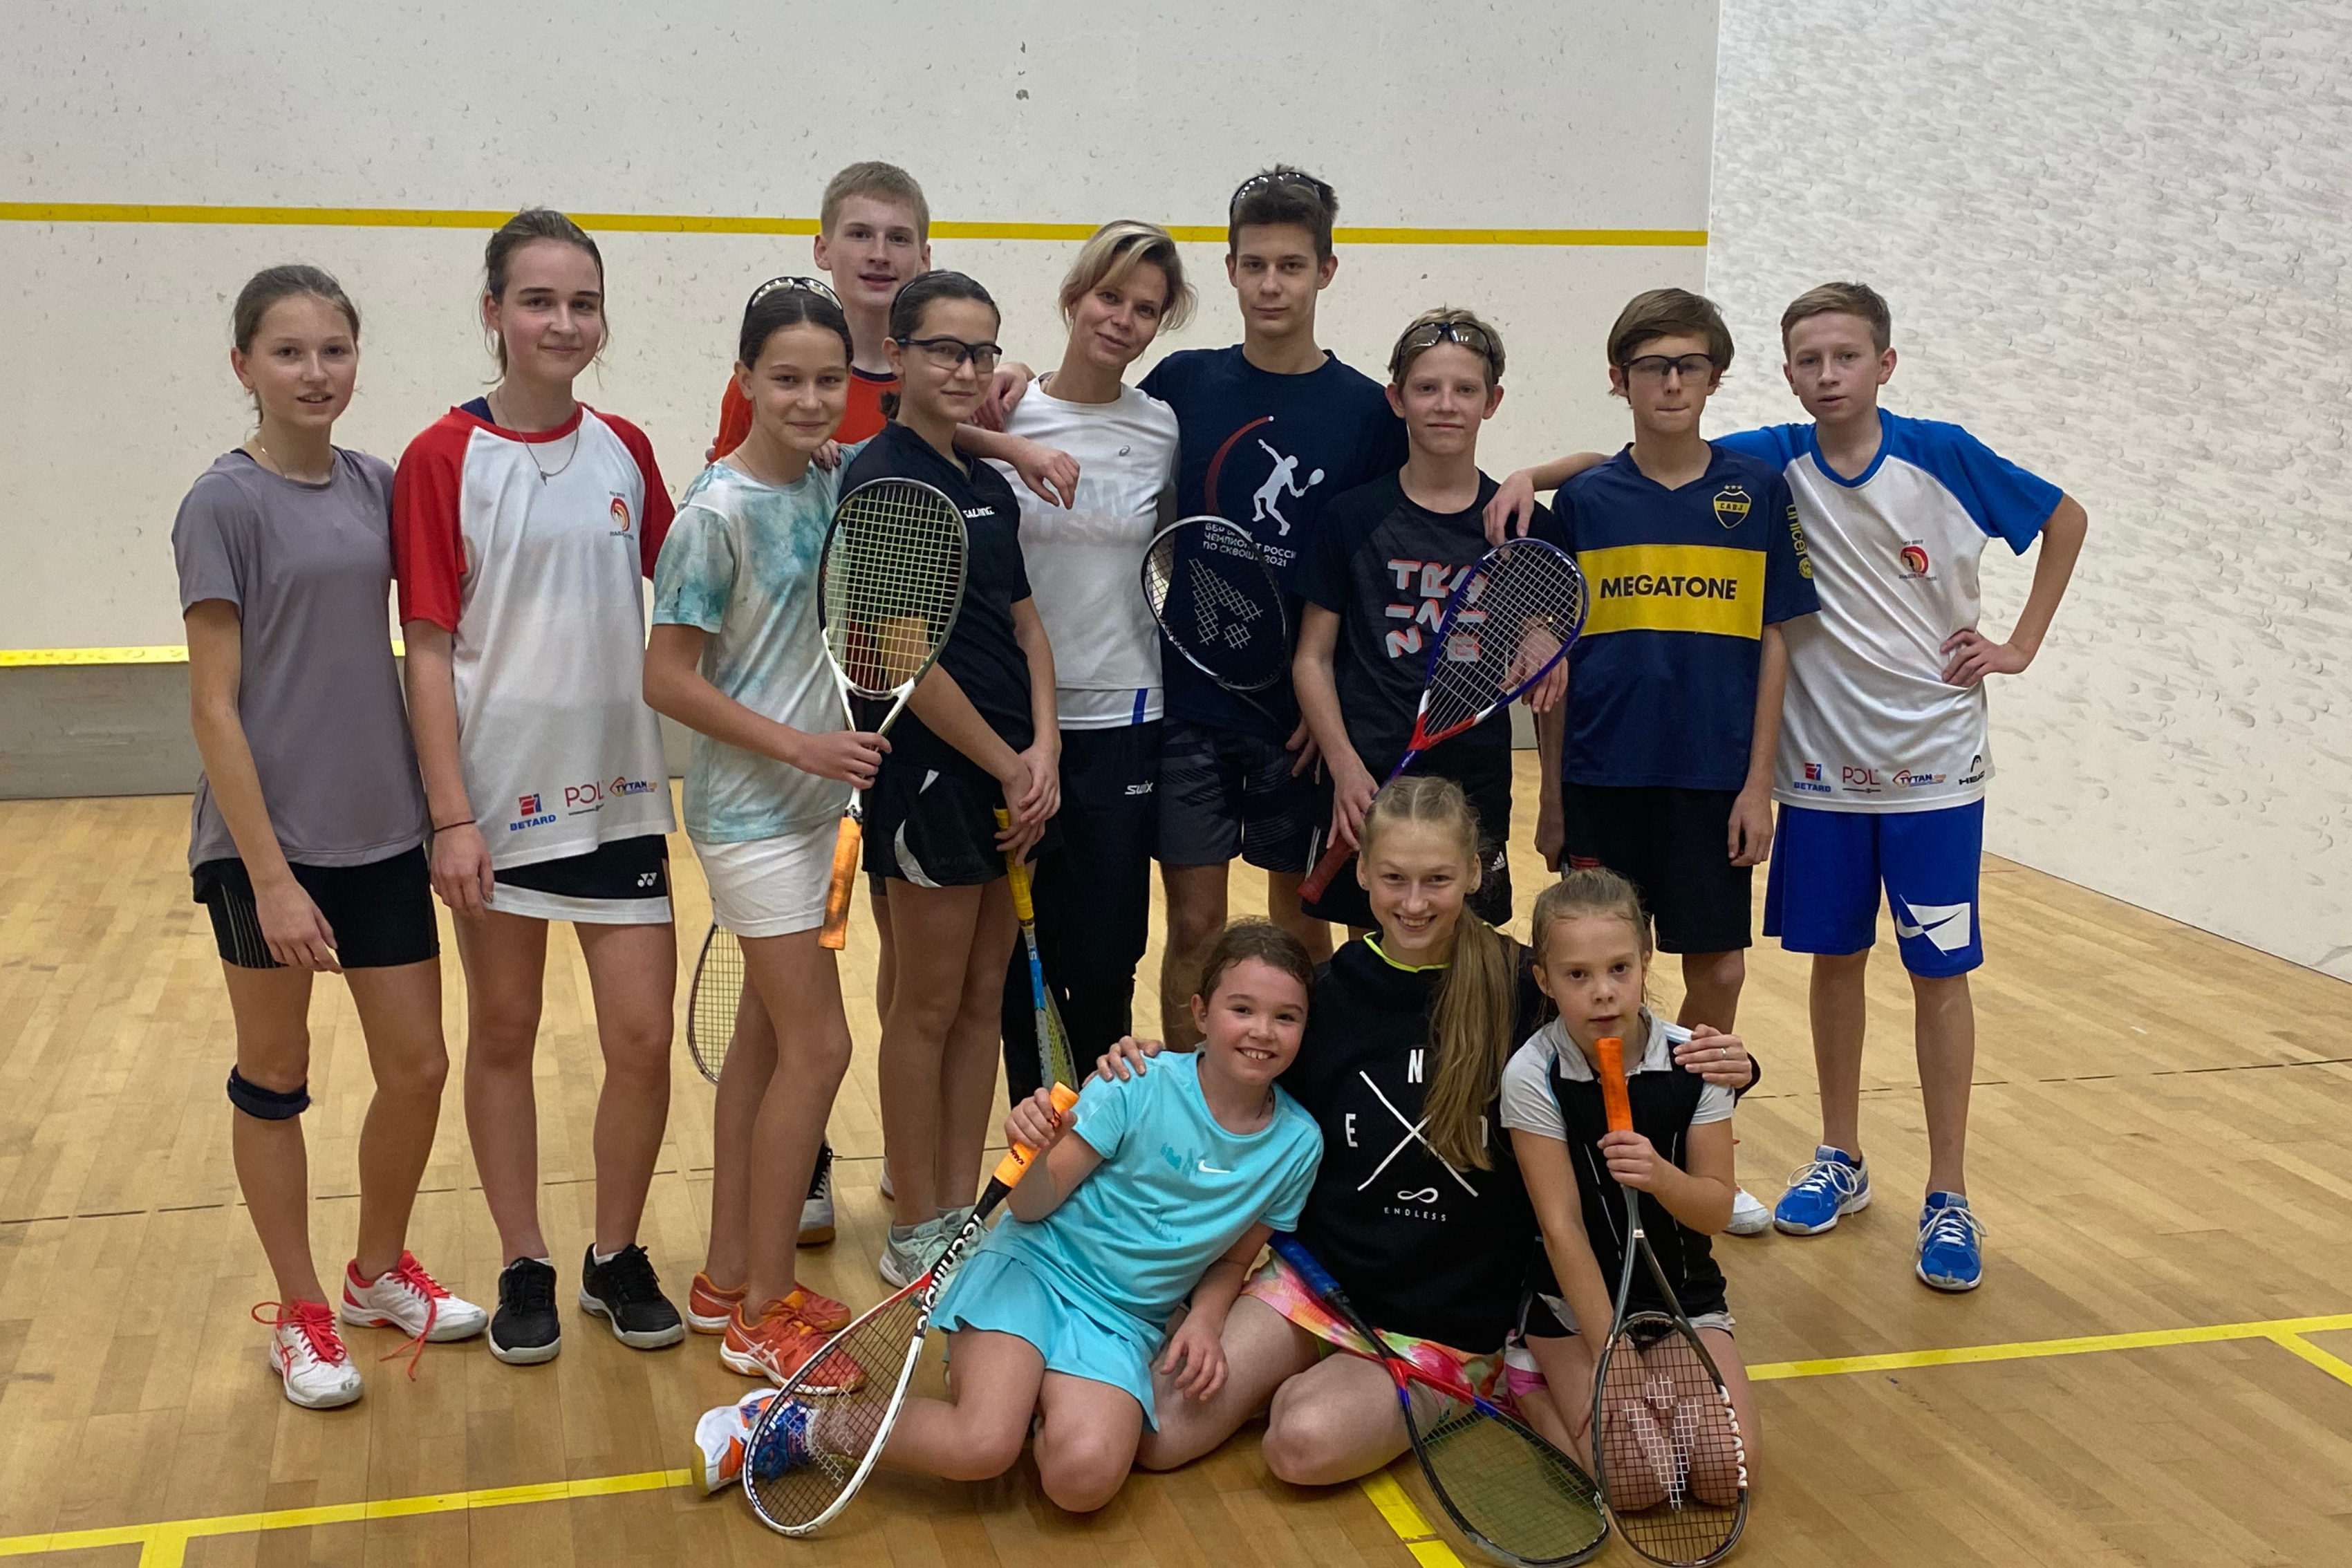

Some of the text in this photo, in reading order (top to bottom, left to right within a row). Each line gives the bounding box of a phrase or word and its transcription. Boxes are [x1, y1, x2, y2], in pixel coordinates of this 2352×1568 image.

[1204, 531, 1262, 550] ЧЕМПИОТ
[1203, 541, 1287, 567] ПО СКВОШ 2021
[1600, 574, 1737, 600] MEGATONE
[616, 781, 647, 792] TYTAN
[1793, 781, 1831, 793] BETARD
[1900, 774, 1932, 785] TYTAN
[510, 814, 557, 832] BETARD
[1384, 1207, 1447, 1222] ENDLESS
